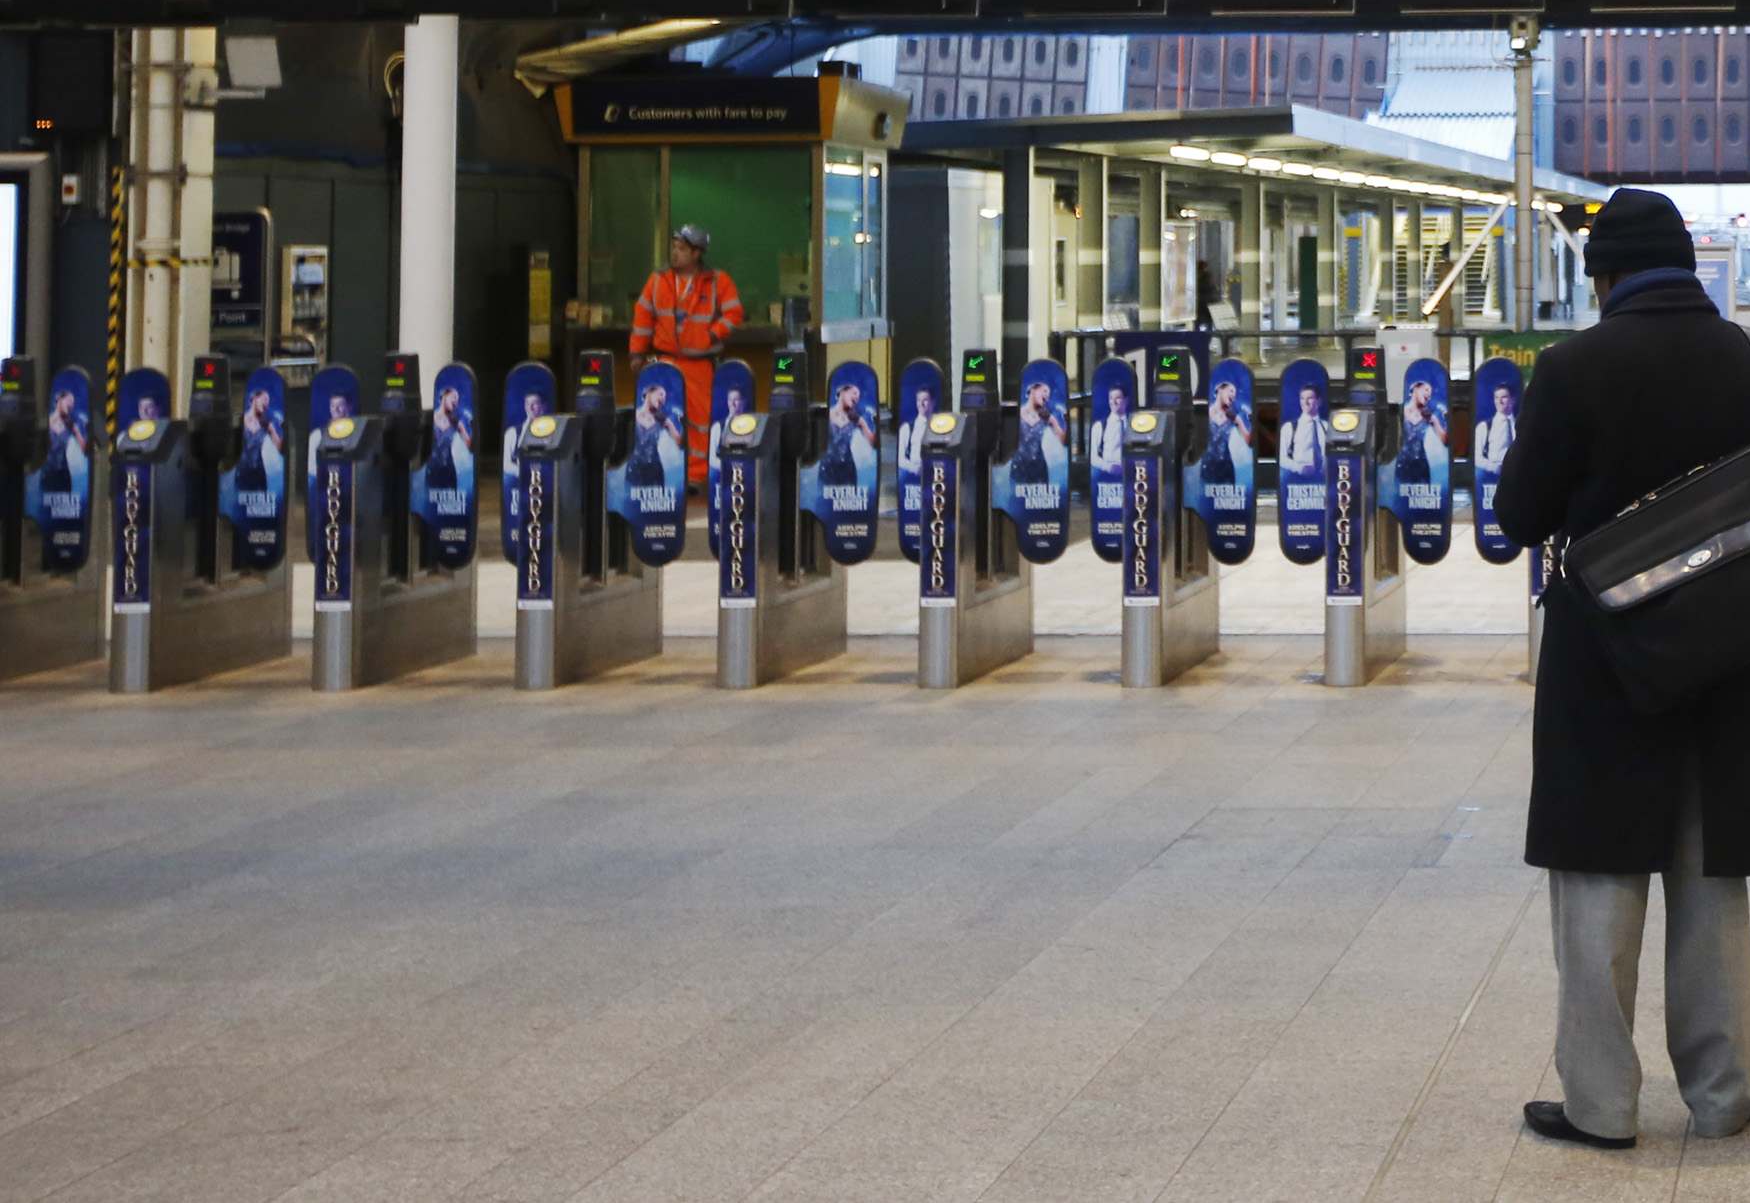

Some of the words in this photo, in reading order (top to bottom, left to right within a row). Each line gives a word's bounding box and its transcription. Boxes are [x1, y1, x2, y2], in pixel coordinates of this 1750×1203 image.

[628, 106, 692, 121] Customers
[695, 106, 721, 120] with
[724, 106, 748, 120] fare
[750, 107, 763, 120] to
[766, 107, 788, 123] pay
[824, 487, 867, 497] BEVERLEY
[1016, 485, 1058, 497] BEVERLEY
[1207, 486, 1244, 497] BEVERLEY
[1401, 485, 1440, 496] BEVERLEY
[832, 497, 867, 510] KNIGHT
[1025, 497, 1059, 509] KNIGHT
[1214, 497, 1245, 509] KNIGHT
[1409, 496, 1441, 509] KNIGHT
[325, 468, 341, 595] BODYGUARD
[527, 466, 543, 591] BODYGUARD
[729, 467, 745, 591] BODYGUARD
[930, 465, 946, 591] BODYGUARD
[1132, 465, 1148, 590] BODYGUARD
[1335, 465, 1351, 588] BODYGUARD
